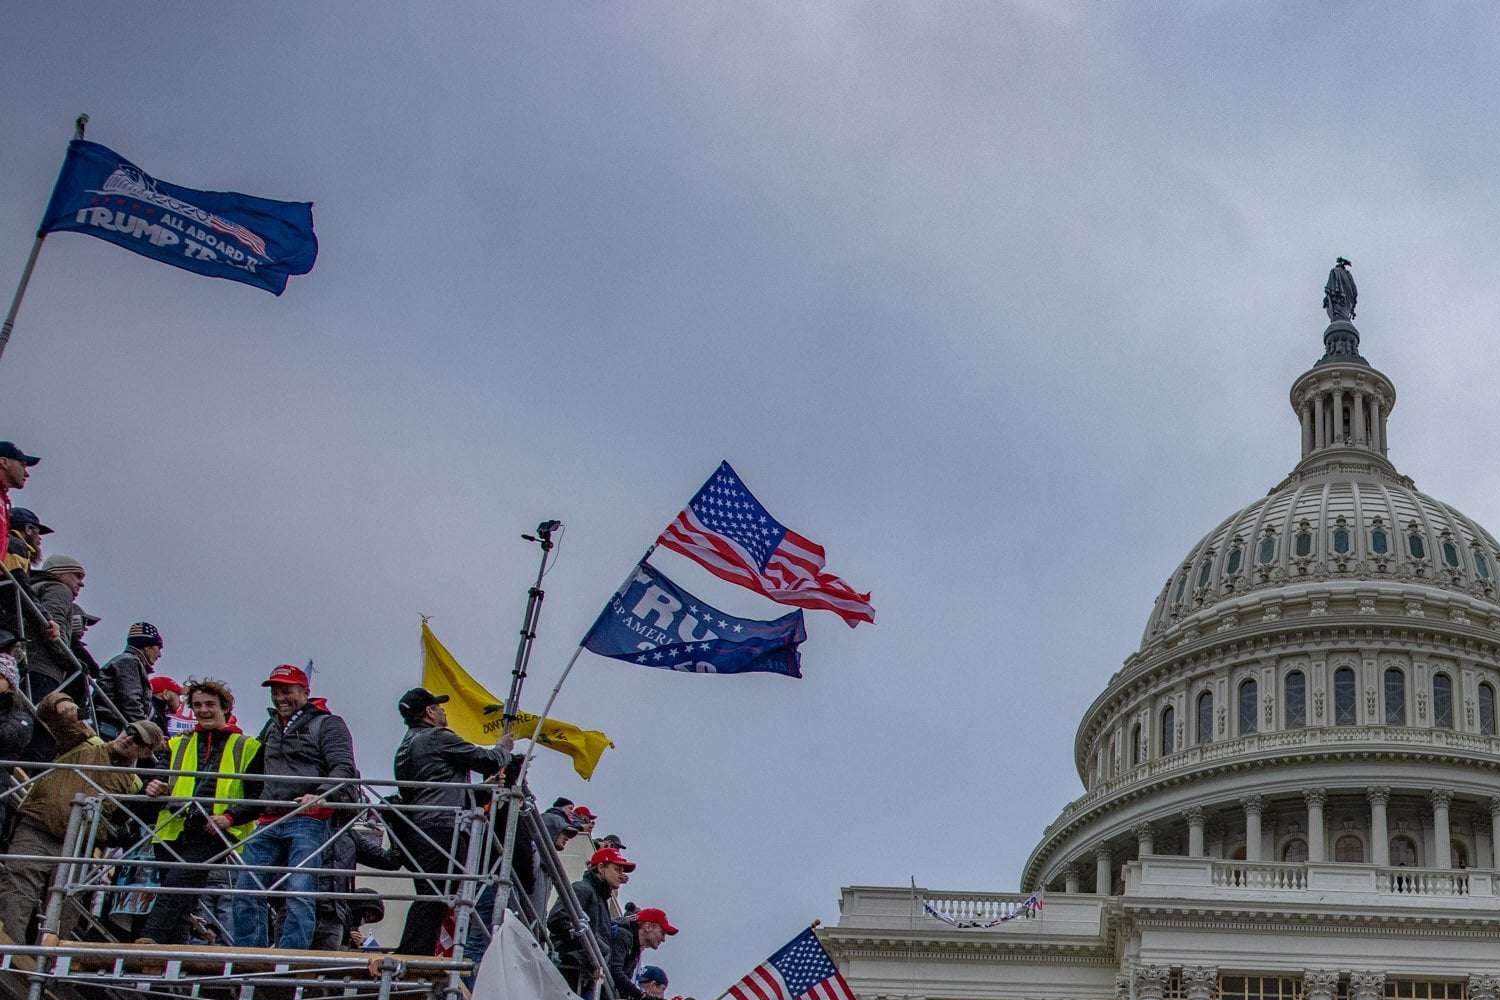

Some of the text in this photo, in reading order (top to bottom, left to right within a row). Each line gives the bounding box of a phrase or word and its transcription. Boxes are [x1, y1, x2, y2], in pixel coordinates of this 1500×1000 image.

[75, 206, 180, 247] TRUMP
[160, 213, 184, 232] ALL
[187, 223, 245, 264] ABOARD
[622, 617, 672, 646] AMER
